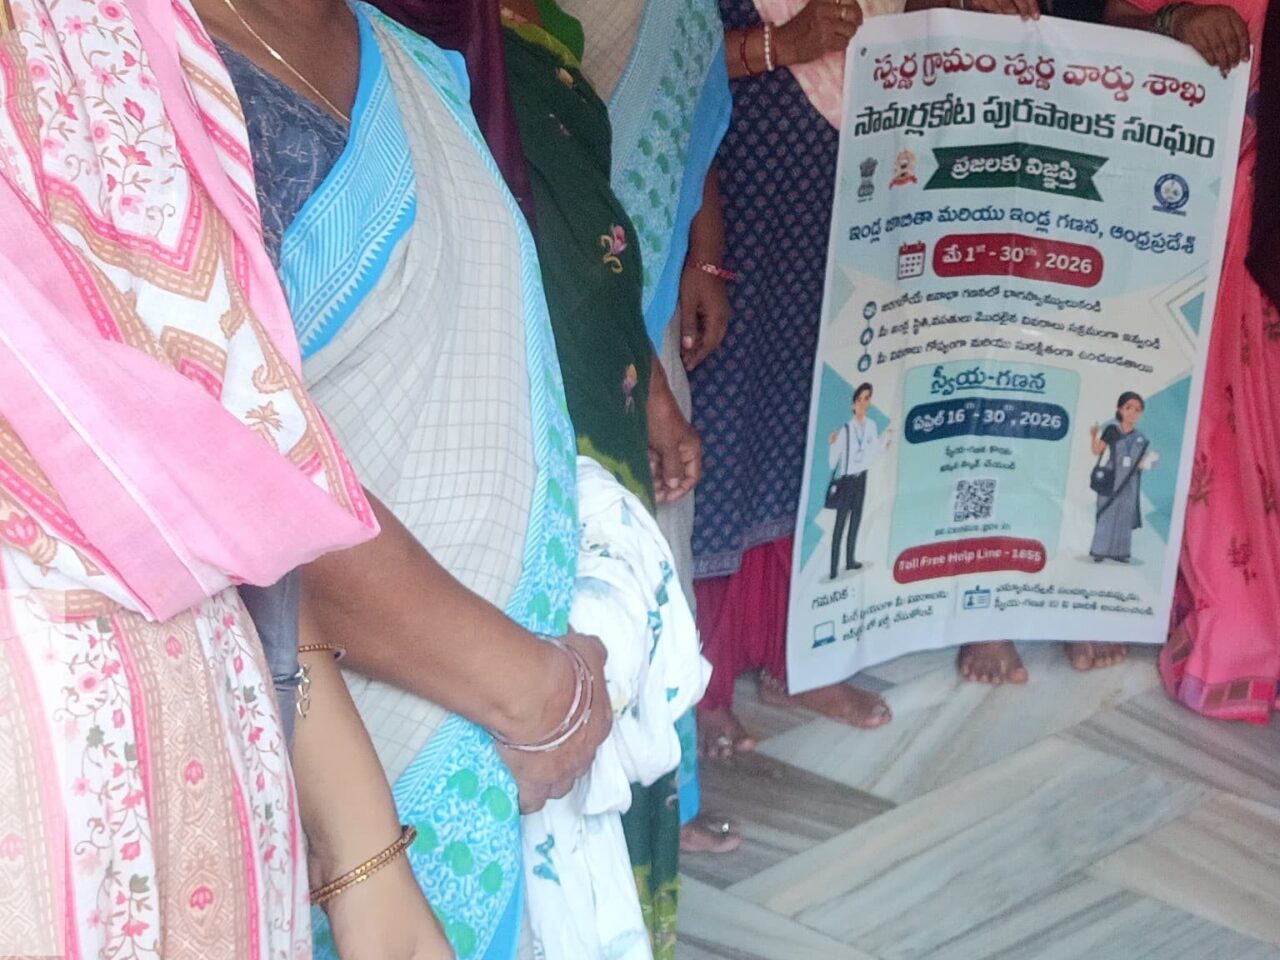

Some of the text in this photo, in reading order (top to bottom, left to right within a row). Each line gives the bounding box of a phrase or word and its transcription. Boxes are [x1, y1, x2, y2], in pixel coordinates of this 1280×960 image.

[874, 48, 1206, 107] స్వర్ణ గ్రామం స్వర్ణ వార్డు శాఖ
[983, 96, 1116, 139] పురపాలక
[1122, 116, 1215, 159] సంఘం
[951, 154, 1077, 190] ప్రజలకు విజ్ఞప్తి
[938, 205, 1005, 223] మరియు
[942, 244, 963, 263] మే
[1045, 253, 1093, 274] 2026
[931, 365, 1046, 395] స్వీయ-గణన
[1019, 411, 1062, 428] 2026
[899, 558, 919, 570] Toll
[920, 555, 946, 567] Free
[948, 550, 975, 564] Help
[977, 548, 1002, 559] Line
